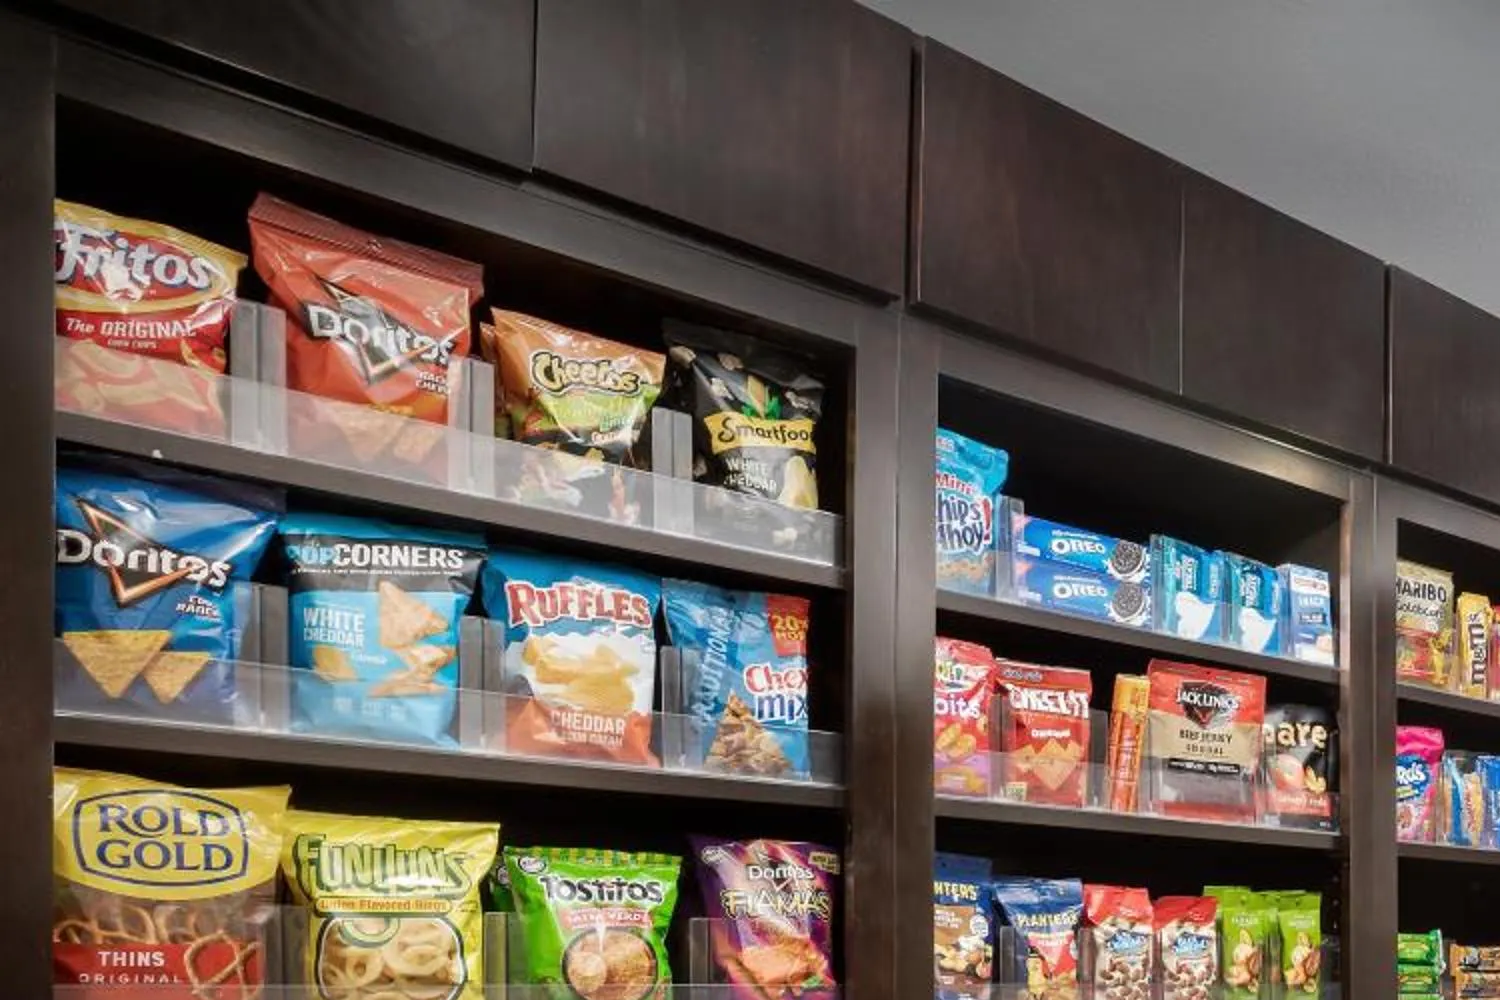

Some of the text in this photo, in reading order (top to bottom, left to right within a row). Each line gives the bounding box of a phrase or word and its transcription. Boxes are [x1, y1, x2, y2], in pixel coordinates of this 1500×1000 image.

[54, 222, 213, 290] Fritos
[65, 317, 197, 338] The ORIGINAL
[308, 304, 457, 364] Doritos
[533, 351, 641, 393] Cheetos
[717, 418, 810, 442] Smartfoo
[727, 457, 768, 474] WHITE
[938, 493, 981, 526] hips
[56, 530, 232, 589] Doritos
[1052, 538, 1106, 555] OREO
[1053, 582, 1109, 599] OREO
[505, 582, 652, 626] RUFFLES
[303, 608, 365, 632] WHITE
[303, 631, 365, 648] CHEDDAR
[745, 664, 811, 693] Chex
[551, 711, 626, 733] CHEDDAR
[757, 695, 809, 724] mix
[99, 804, 230, 836] ROLD
[96, 840, 233, 872] GOLD
[99, 951, 165, 968] THINS
[79, 973, 183, 985] ORIGINAL
